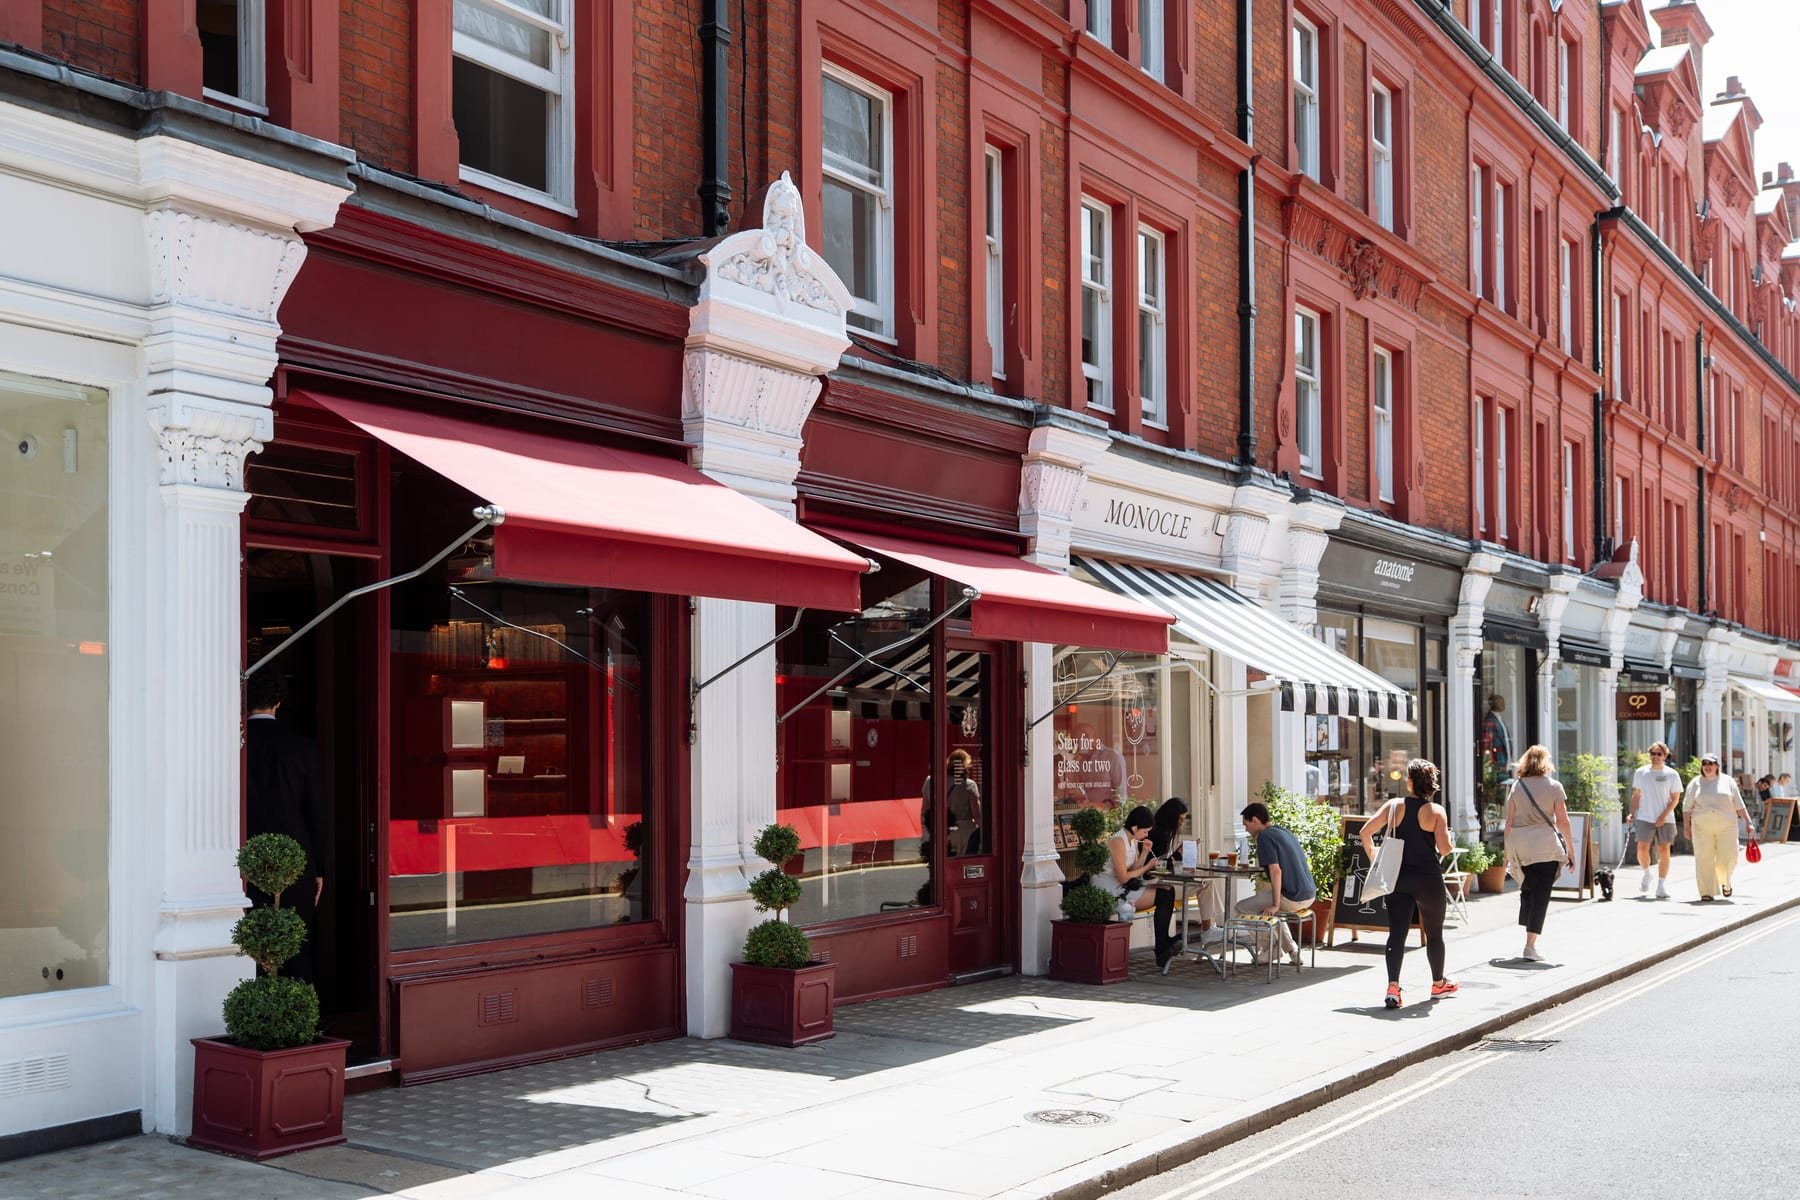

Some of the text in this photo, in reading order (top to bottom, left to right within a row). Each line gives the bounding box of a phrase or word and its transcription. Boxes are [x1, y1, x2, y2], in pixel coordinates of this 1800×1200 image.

[1104, 499, 1192, 539] MONOCLE
[1057, 732, 1102, 754] Stay for a
[1057, 755, 1111, 777] glass or two
